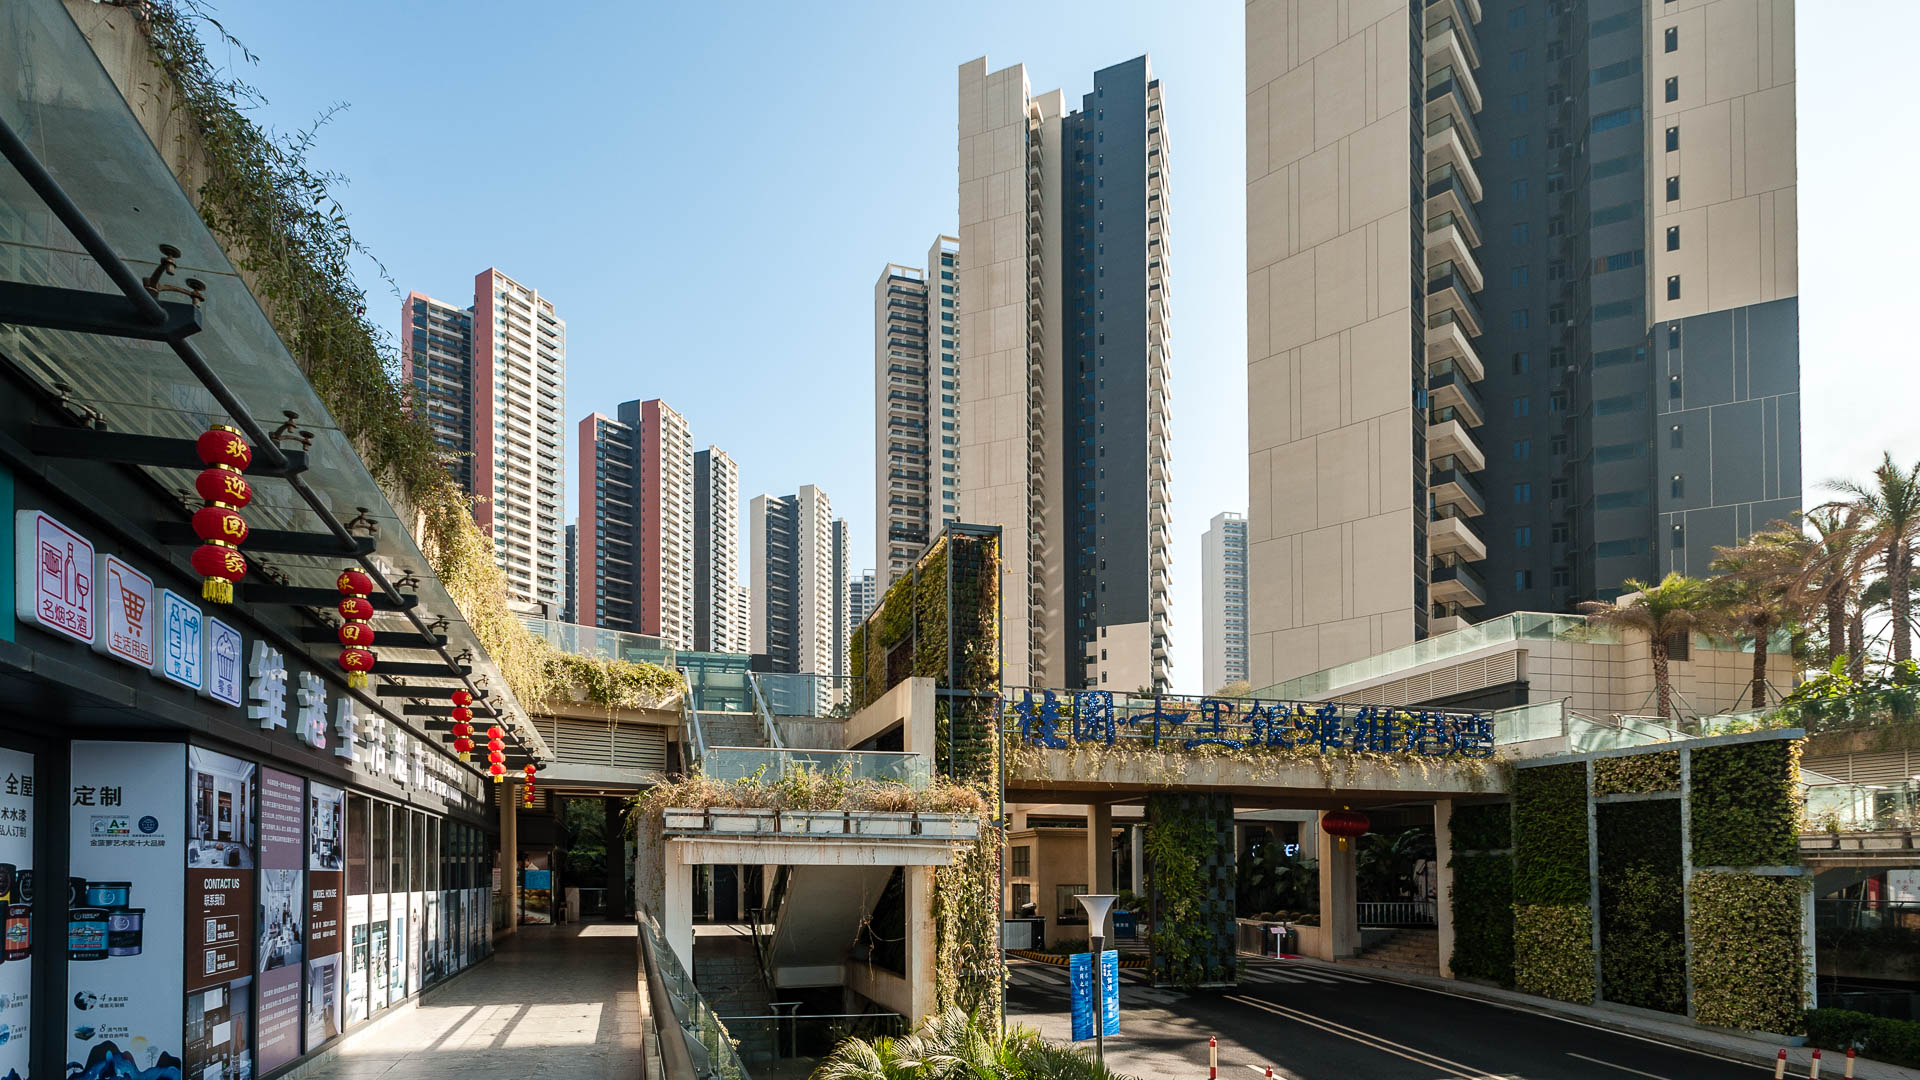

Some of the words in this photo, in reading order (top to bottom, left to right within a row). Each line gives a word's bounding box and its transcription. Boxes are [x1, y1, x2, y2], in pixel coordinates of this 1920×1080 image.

[223, 437, 247, 574] 欢迎回家
[43, 599, 87, 634] 名烟名酒
[113, 632, 149, 660] 生活用品
[174, 660, 192, 680] 饮料
[5, 772, 33, 797] 全屋
[72, 785, 122, 807] 定制
[109, 819, 128, 829] A+
[204, 878, 231, 890] CONTACT
[231, 878, 240, 888] US
